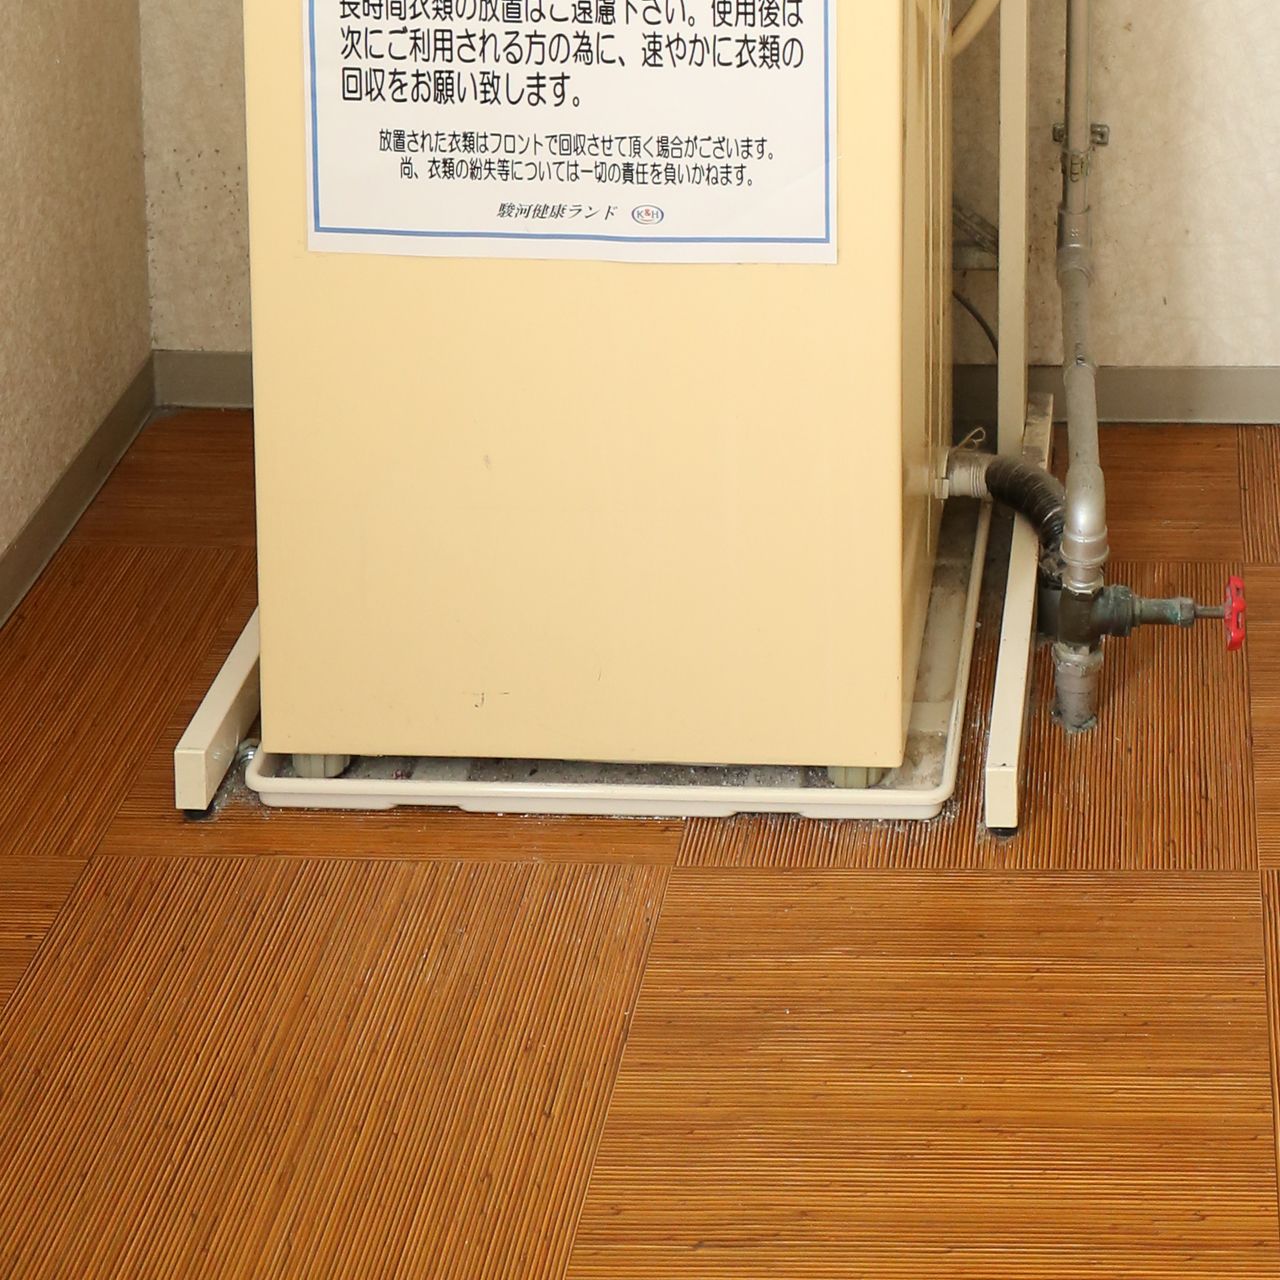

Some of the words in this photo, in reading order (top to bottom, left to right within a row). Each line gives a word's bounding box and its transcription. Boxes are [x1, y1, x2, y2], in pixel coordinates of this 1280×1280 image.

[339, 26, 804, 70] 次にご利用される方の為に、速やかに衣類の
[340, 66, 582, 108] 回収をお願い致します。
[378, 127, 775, 161] 放置された衣類はフロントで回収させて頂く場合がございます。
[399, 155, 754, 188] 尚、衣類の紛失等については一切の責任を負いかねます。
[496, 201, 619, 222] 駿河健康ランド
